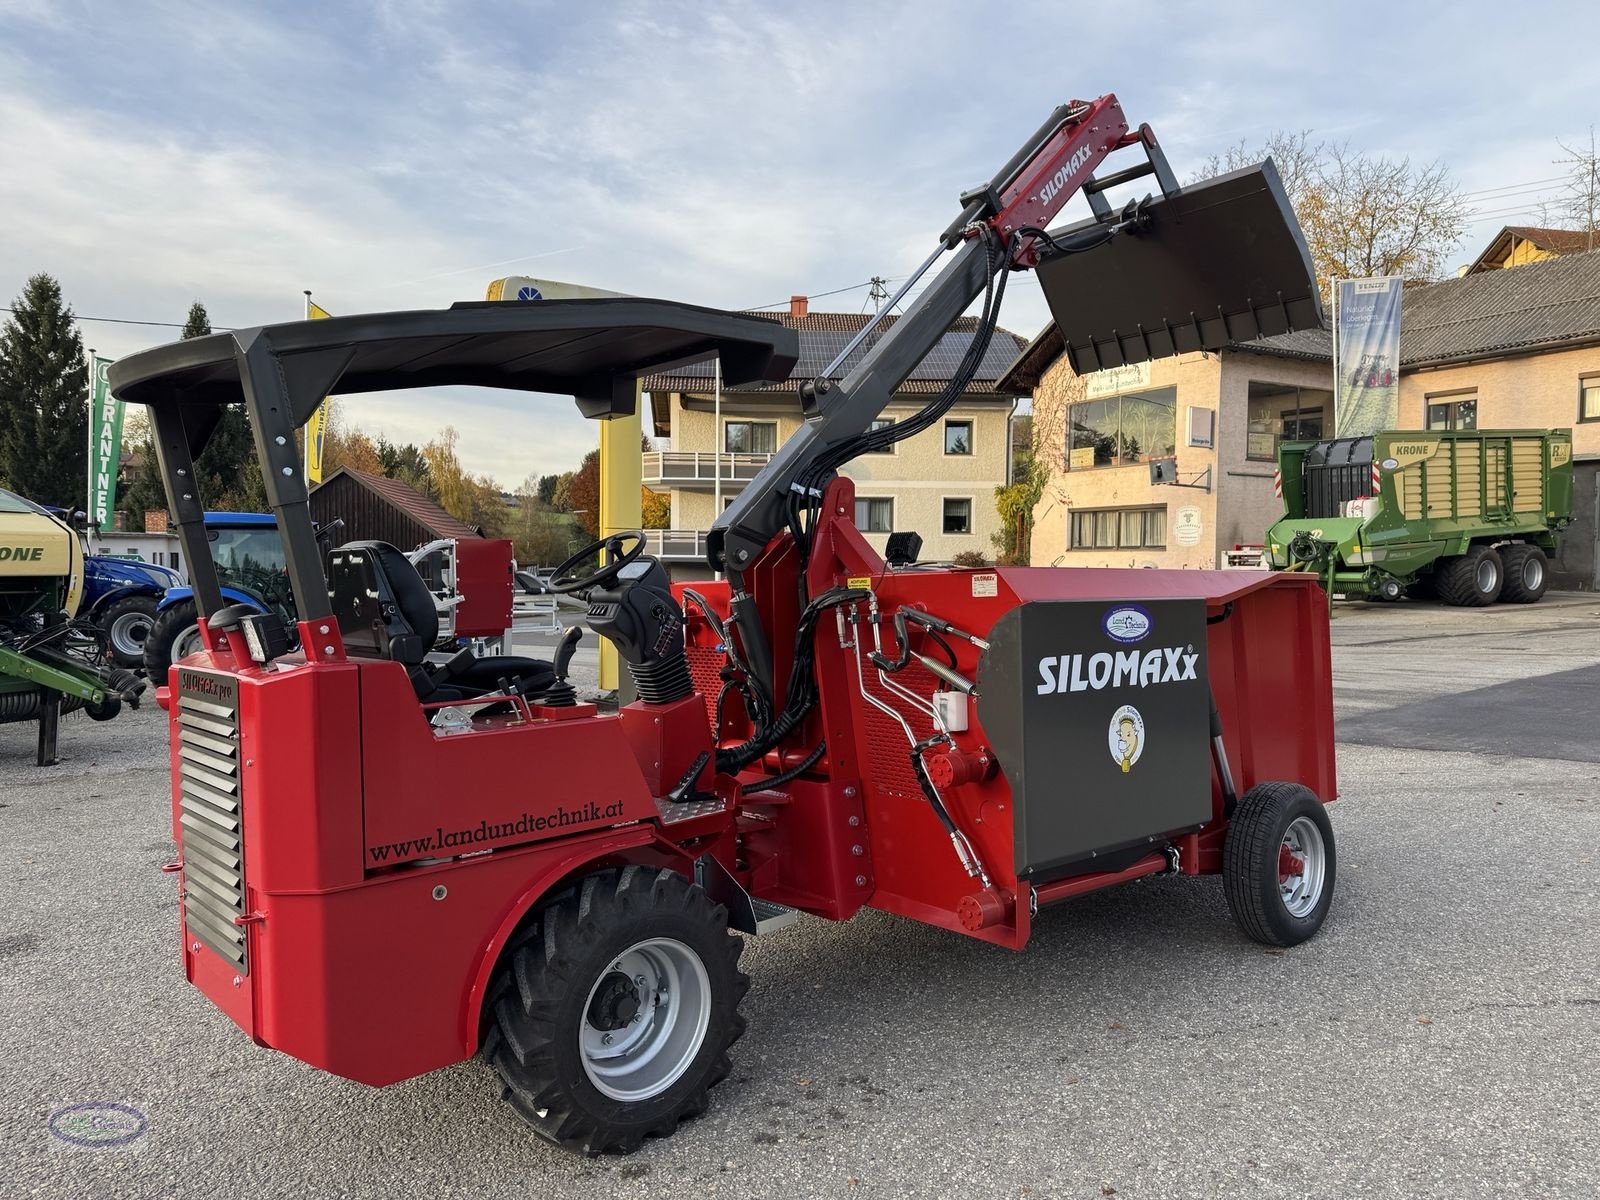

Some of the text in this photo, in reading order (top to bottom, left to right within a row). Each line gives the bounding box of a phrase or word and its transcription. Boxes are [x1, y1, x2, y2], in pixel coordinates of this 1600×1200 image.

[96, 387, 115, 524] BRANTNER
[1396, 445, 1429, 456] KRONE
[370, 800, 624, 862] www.landundtechnik.at
